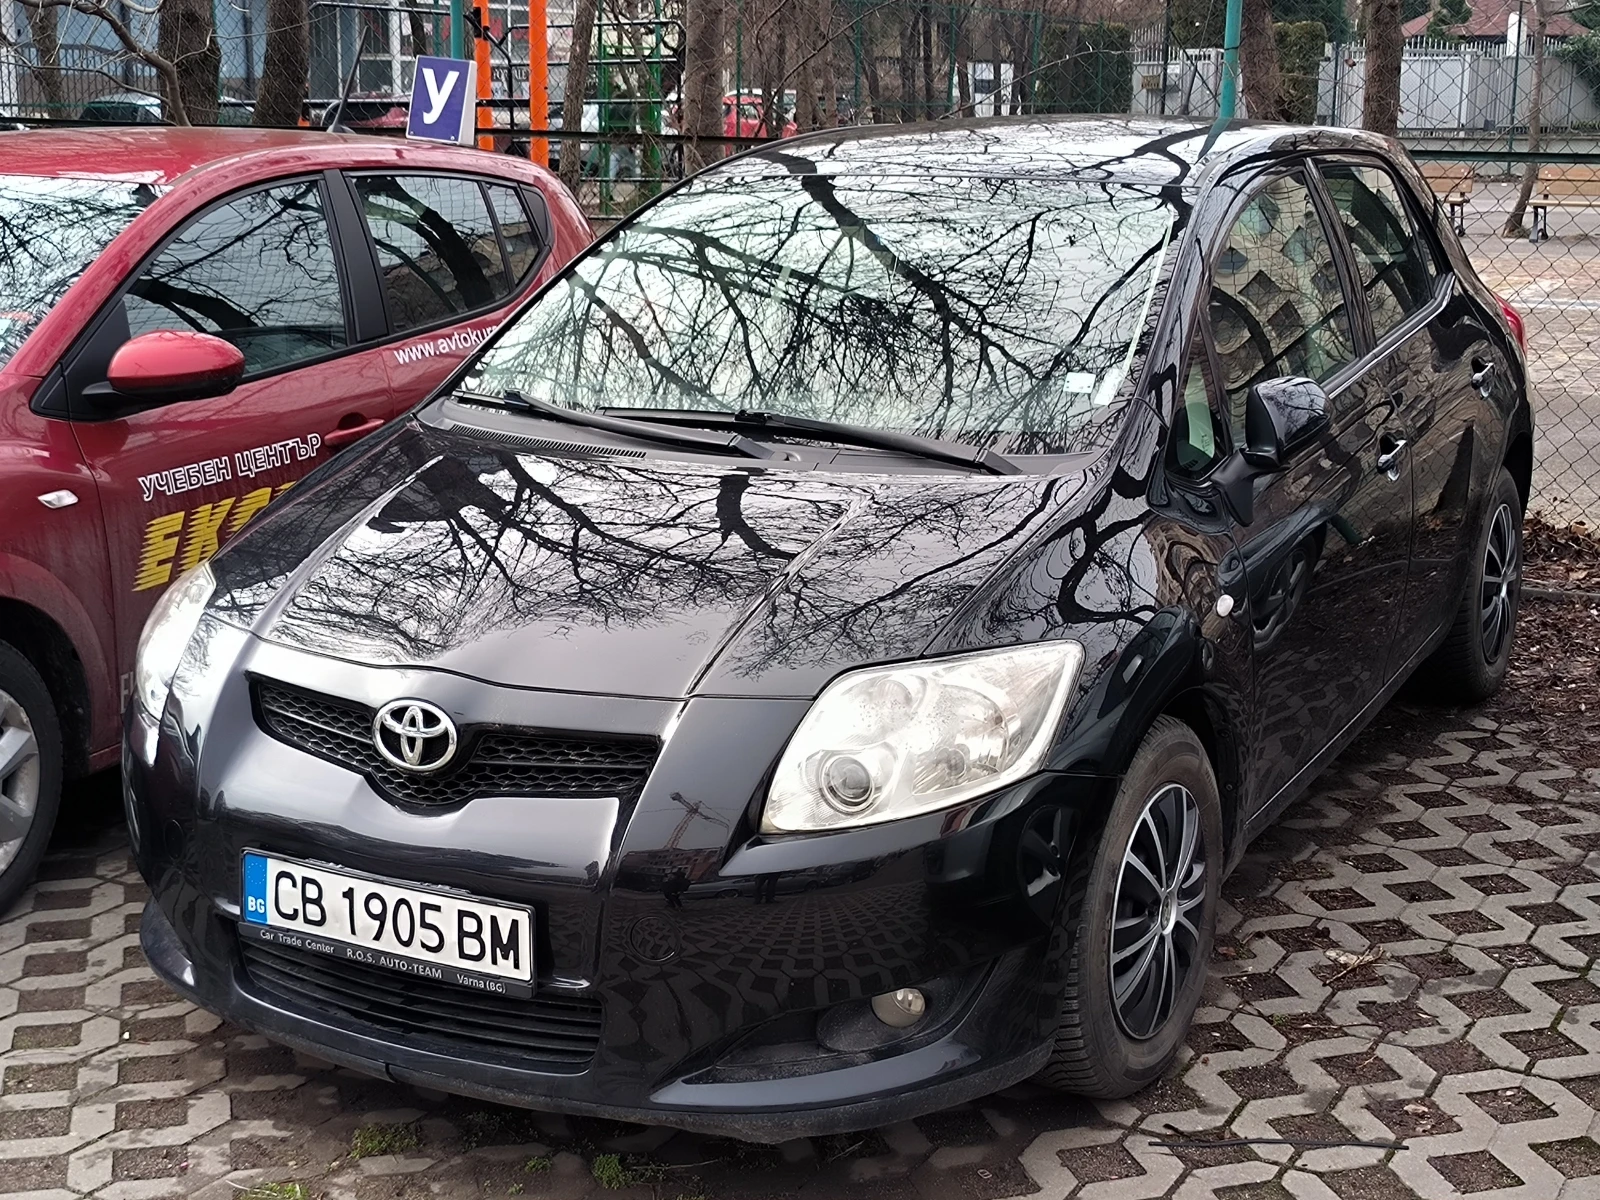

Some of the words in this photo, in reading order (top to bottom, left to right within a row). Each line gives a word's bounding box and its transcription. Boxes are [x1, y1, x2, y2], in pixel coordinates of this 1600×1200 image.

[138, 456, 232, 501] УЧЕБЕН
[235, 433, 322, 478] ЦЕНТЪР
[247, 895, 266, 914] BG
[274, 870, 327, 927] CB
[342, 886, 445, 953] 1905
[457, 909, 521, 970] BM
[260, 929, 275, 940] Car
[278, 933, 302, 947] Trade
[305, 940, 335, 953] Center
[346, 948, 376, 964] R.O.S.
[456, 973, 485, 988] Varna
[486, 980, 507, 994] (BG)
